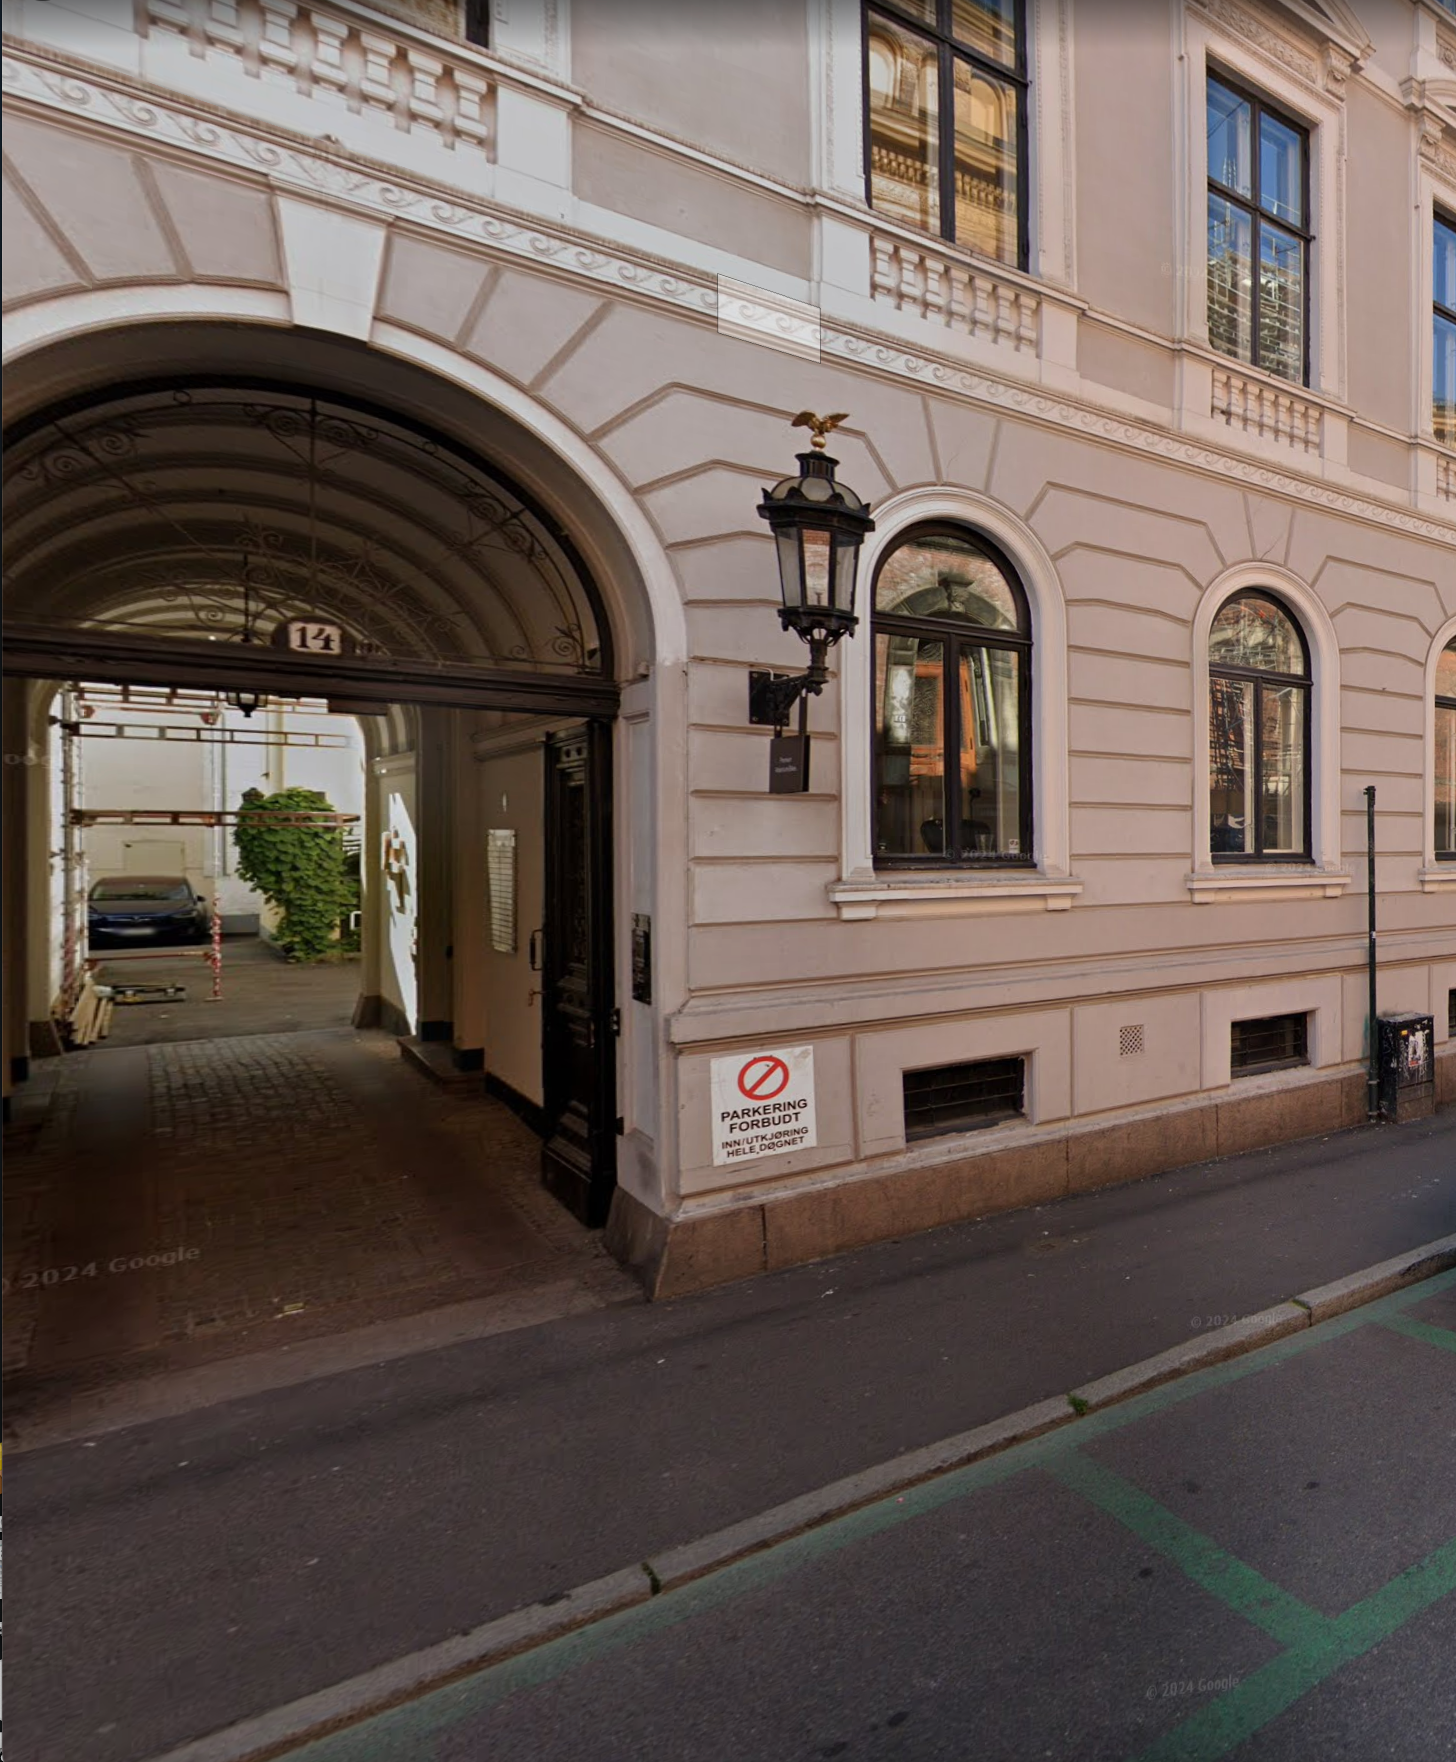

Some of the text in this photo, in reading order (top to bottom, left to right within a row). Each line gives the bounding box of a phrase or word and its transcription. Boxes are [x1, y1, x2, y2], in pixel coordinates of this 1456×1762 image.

[295, 626, 335, 651] 14
[720, 1098, 808, 1122] PARKERING
[729, 1111, 802, 1134] FORBUDT
[721, 1126, 809, 1150] INN/UTKJØRING
[726, 1135, 805, 1158] HELE DØGNET
